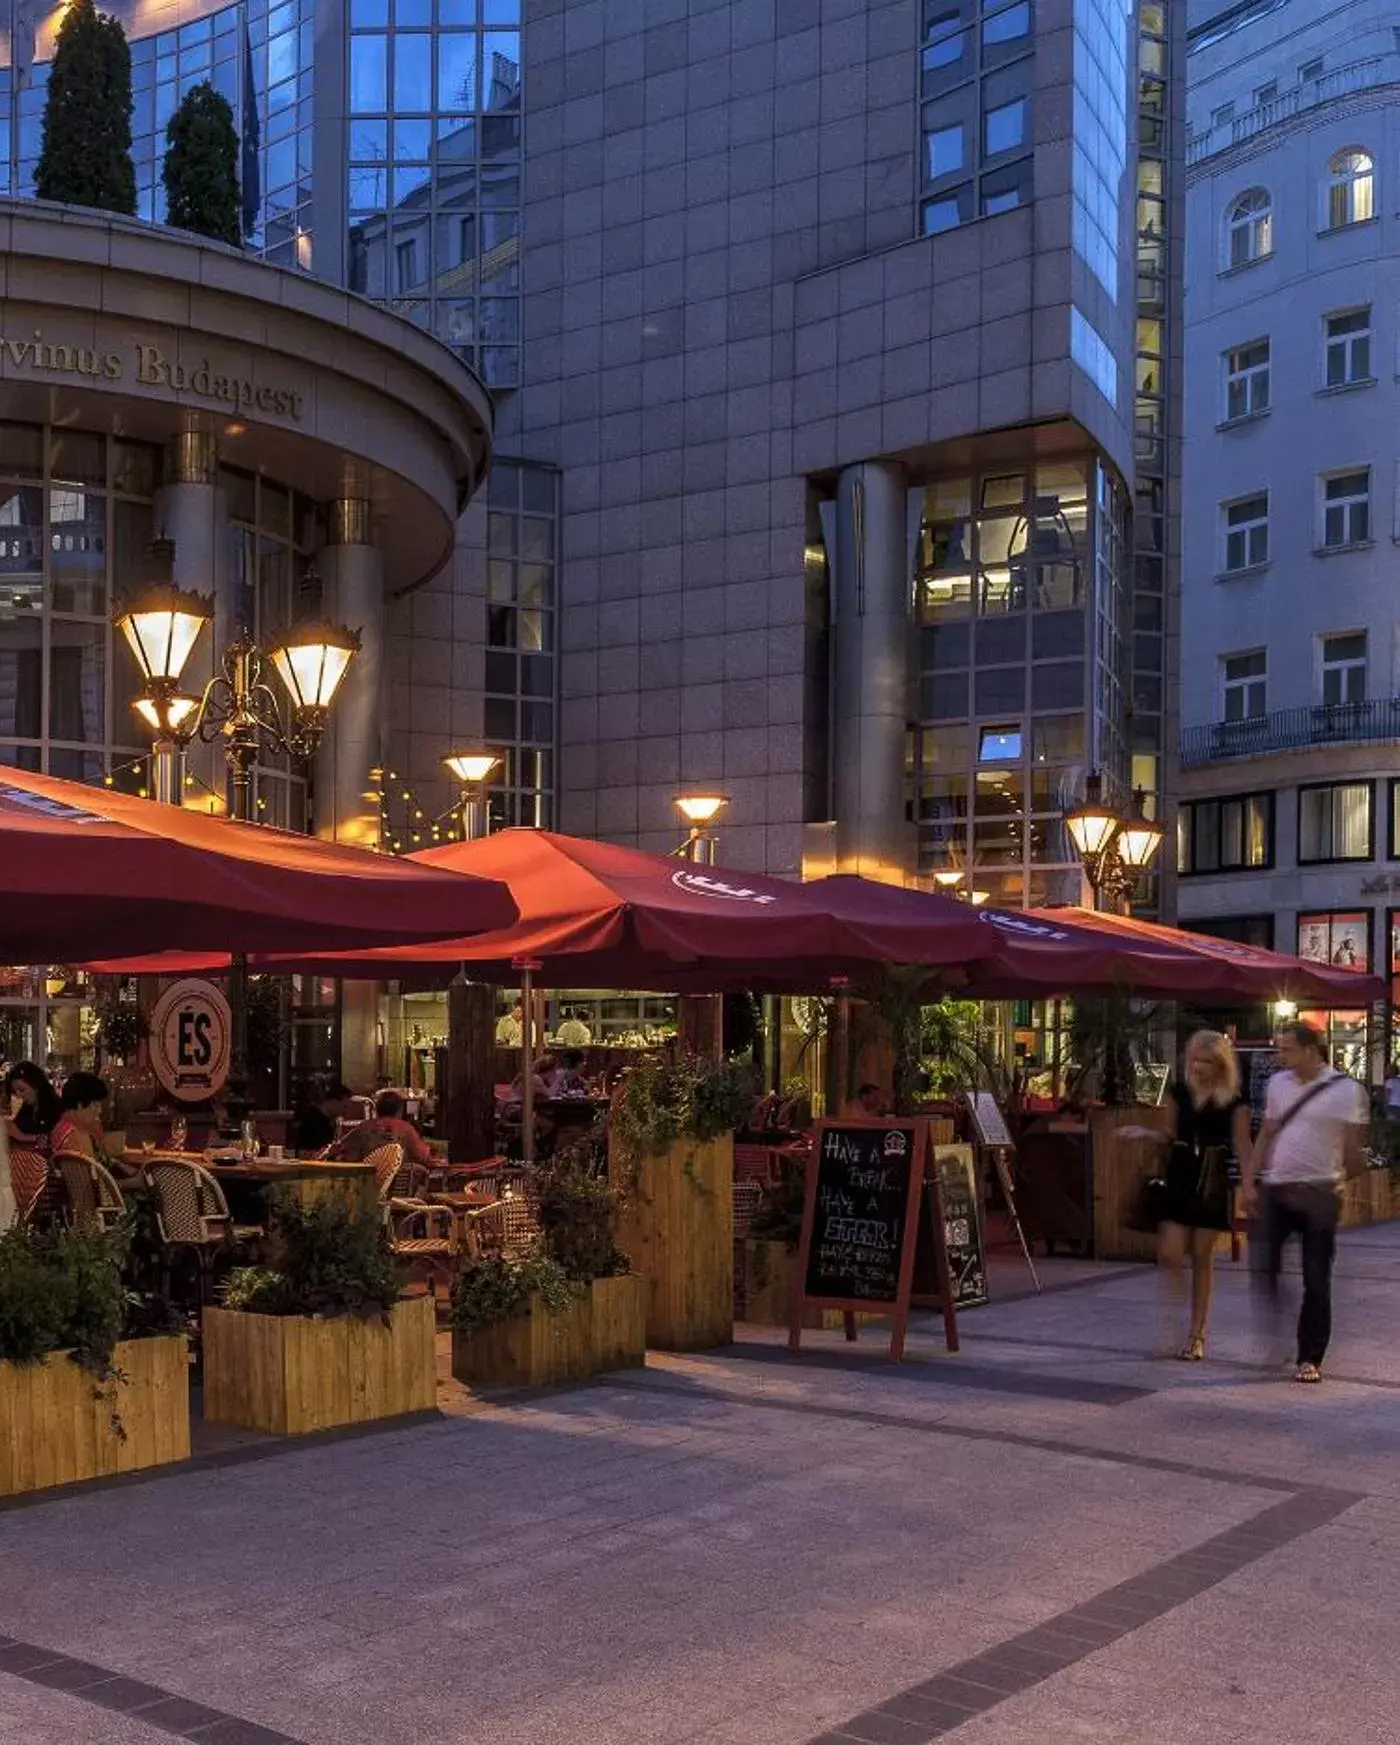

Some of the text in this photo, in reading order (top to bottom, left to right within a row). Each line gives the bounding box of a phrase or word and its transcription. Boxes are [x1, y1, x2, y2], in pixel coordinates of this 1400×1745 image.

[136, 343, 302, 417] Budapest
[178, 1005, 212, 1066] ÉS
[824, 1132, 862, 1165] HAVE
[869, 1146, 881, 1165] A
[866, 1195, 879, 1211] A
